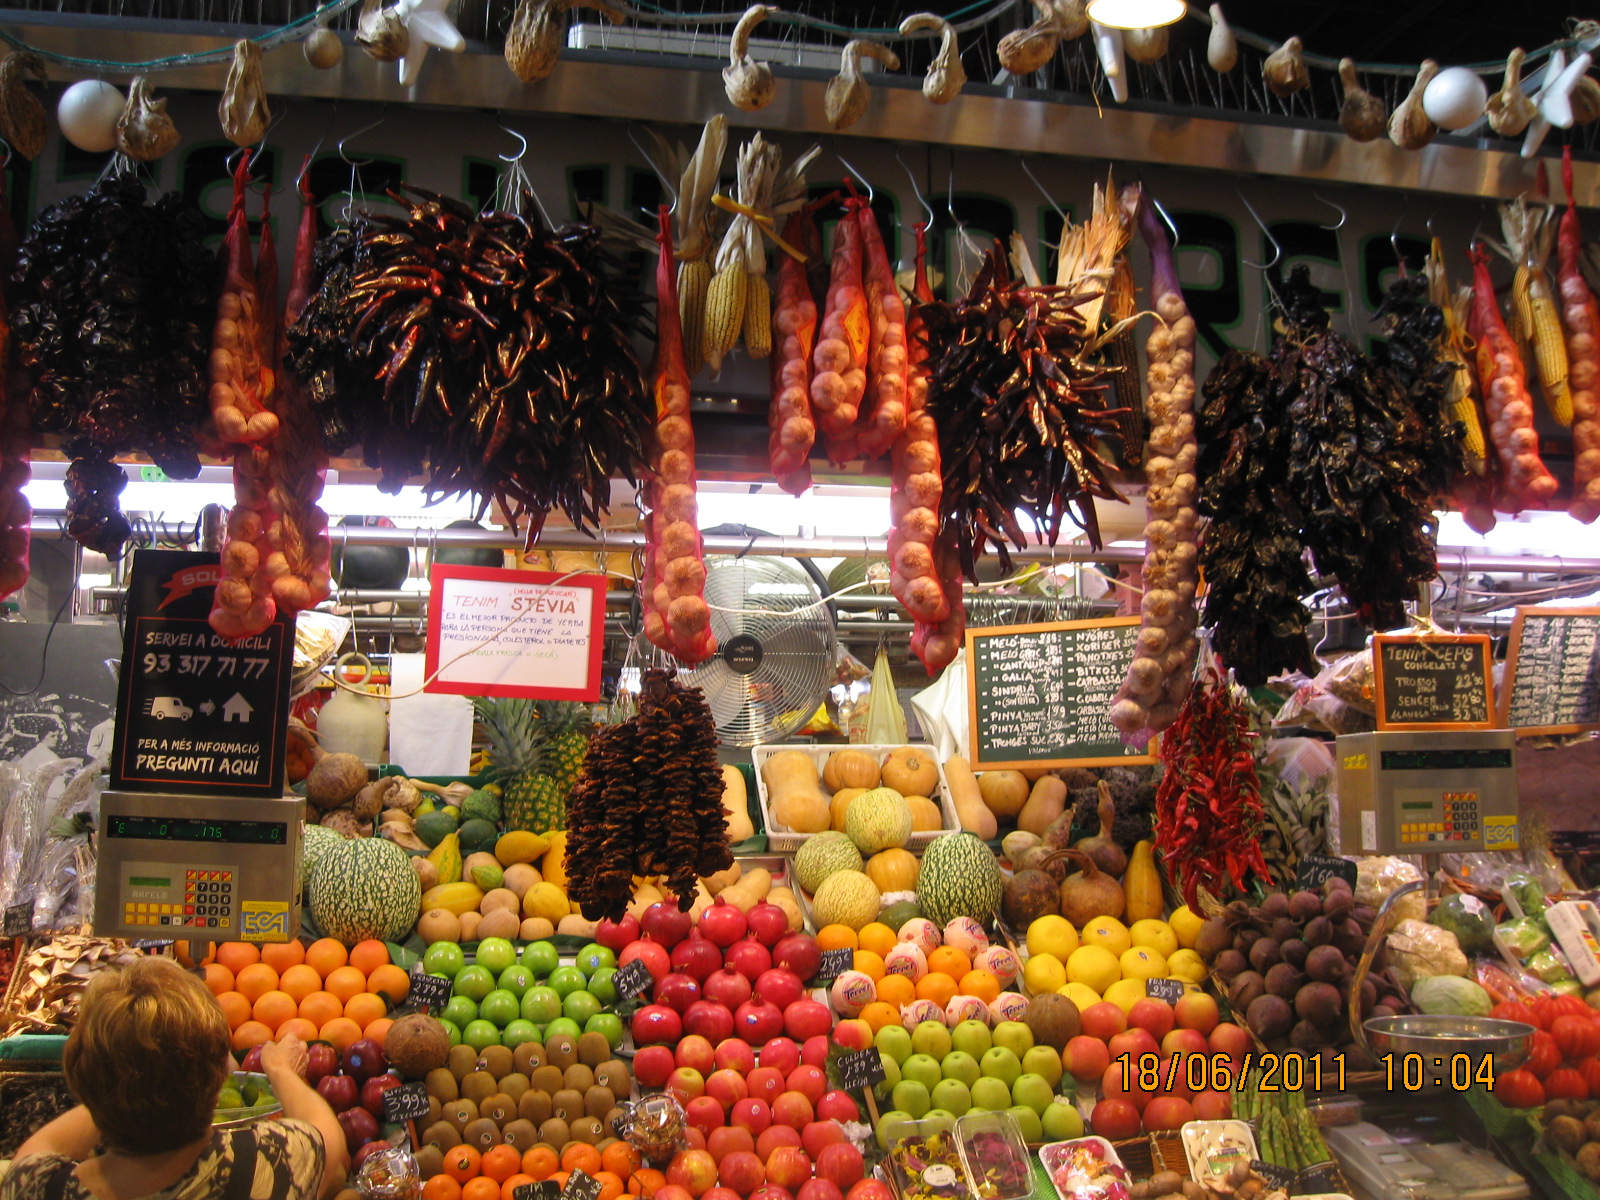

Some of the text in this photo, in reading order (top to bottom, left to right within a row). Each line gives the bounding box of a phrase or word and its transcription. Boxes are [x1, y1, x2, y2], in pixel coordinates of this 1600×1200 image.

[453, 594, 576, 614] TENIM STEVIA
[146, 631, 192, 647] SERVEI
[195, 635, 206, 648] A
[1387, 646, 1474, 662] TENIM CEPS
[143, 652, 269, 680] 93 317 71 77
[138, 738, 158, 750] PER
[161, 741, 168, 751] A
[195, 741, 260, 754] INFORMACIÓ
[136, 754, 261, 776] PREGUNTI AQUÍ
